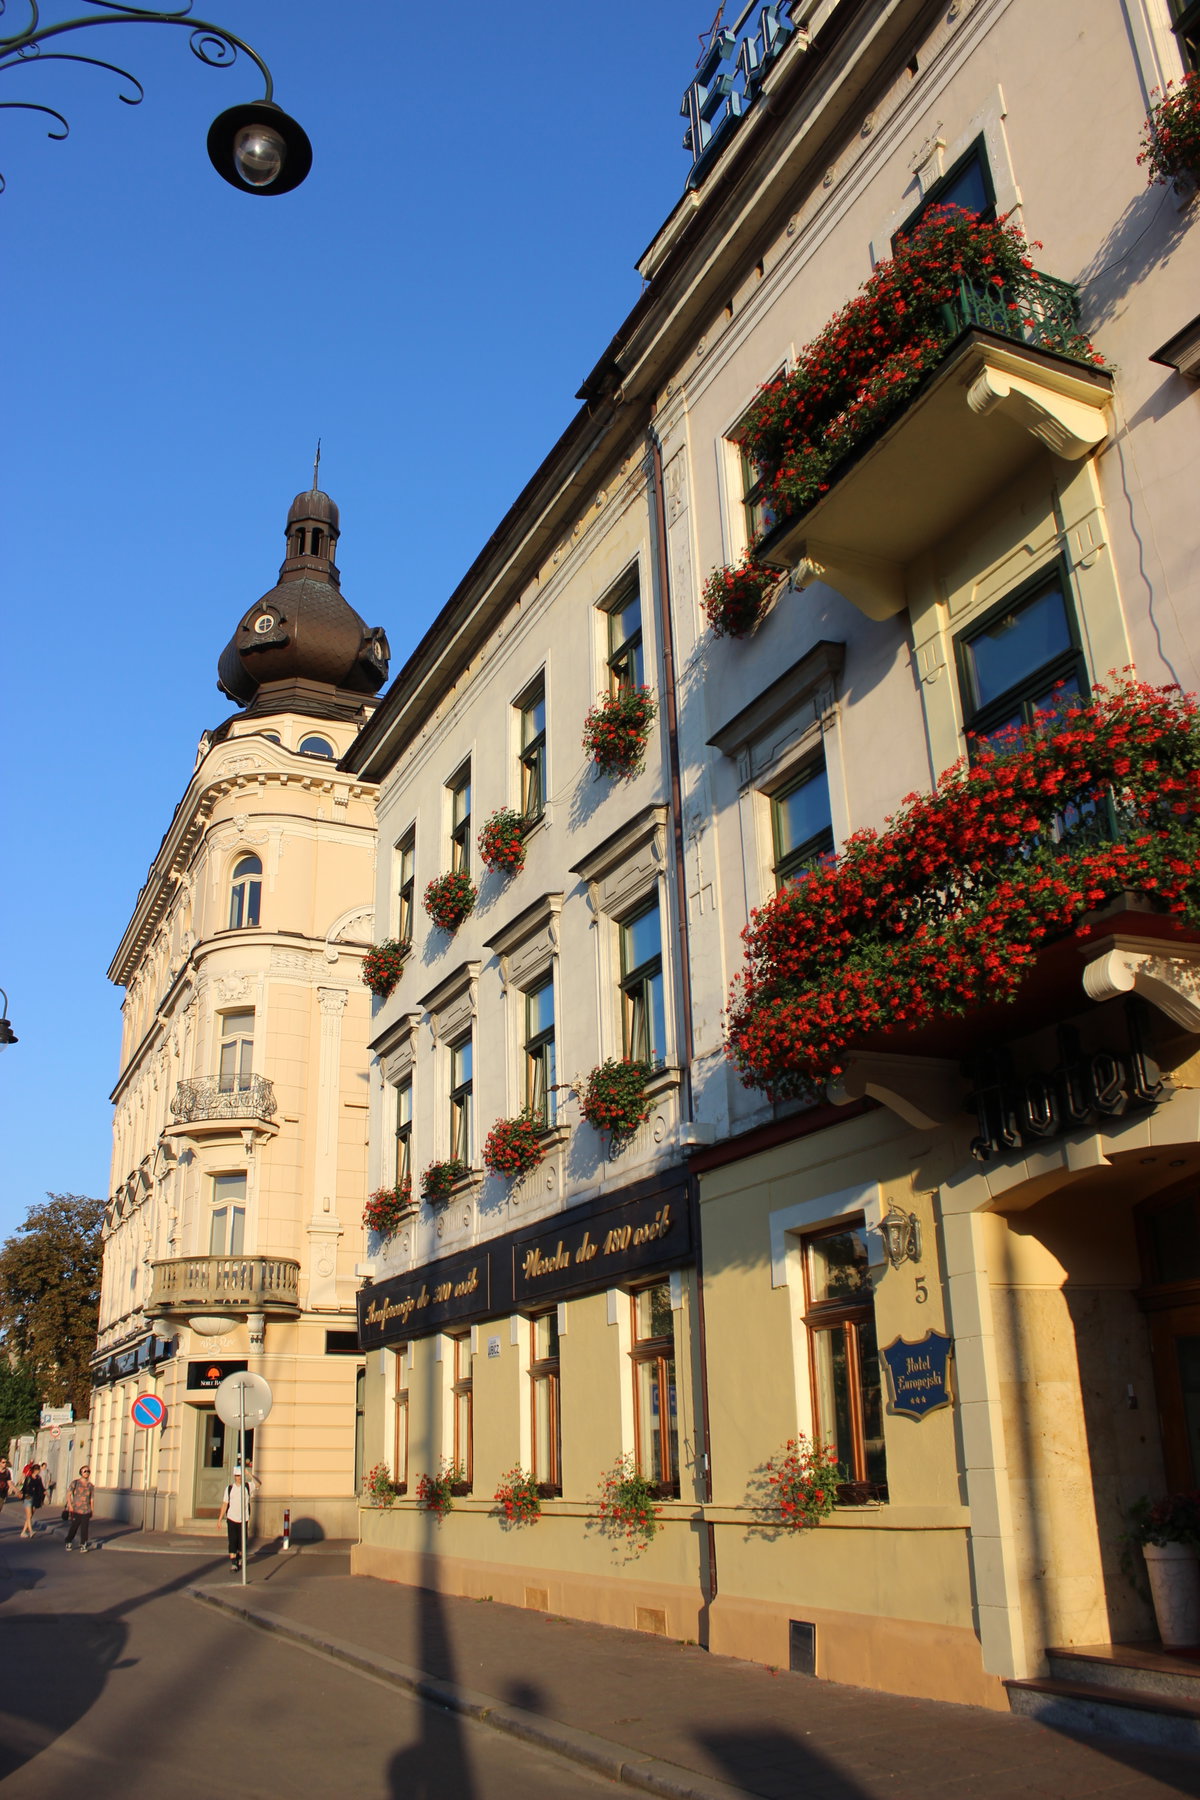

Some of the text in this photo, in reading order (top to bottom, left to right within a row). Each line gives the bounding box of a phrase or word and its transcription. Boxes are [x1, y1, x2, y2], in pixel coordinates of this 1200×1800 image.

[522, 1204, 671, 1281] Wesela do 180 osób
[416, 1284, 430, 1309] do
[432, 1281, 452, 1304] 300
[454, 1266, 479, 1297] osób
[914, 1278, 928, 1303] 5
[906, 1355, 931, 1376] Hotel
[897, 1371, 942, 1394] Europejski
